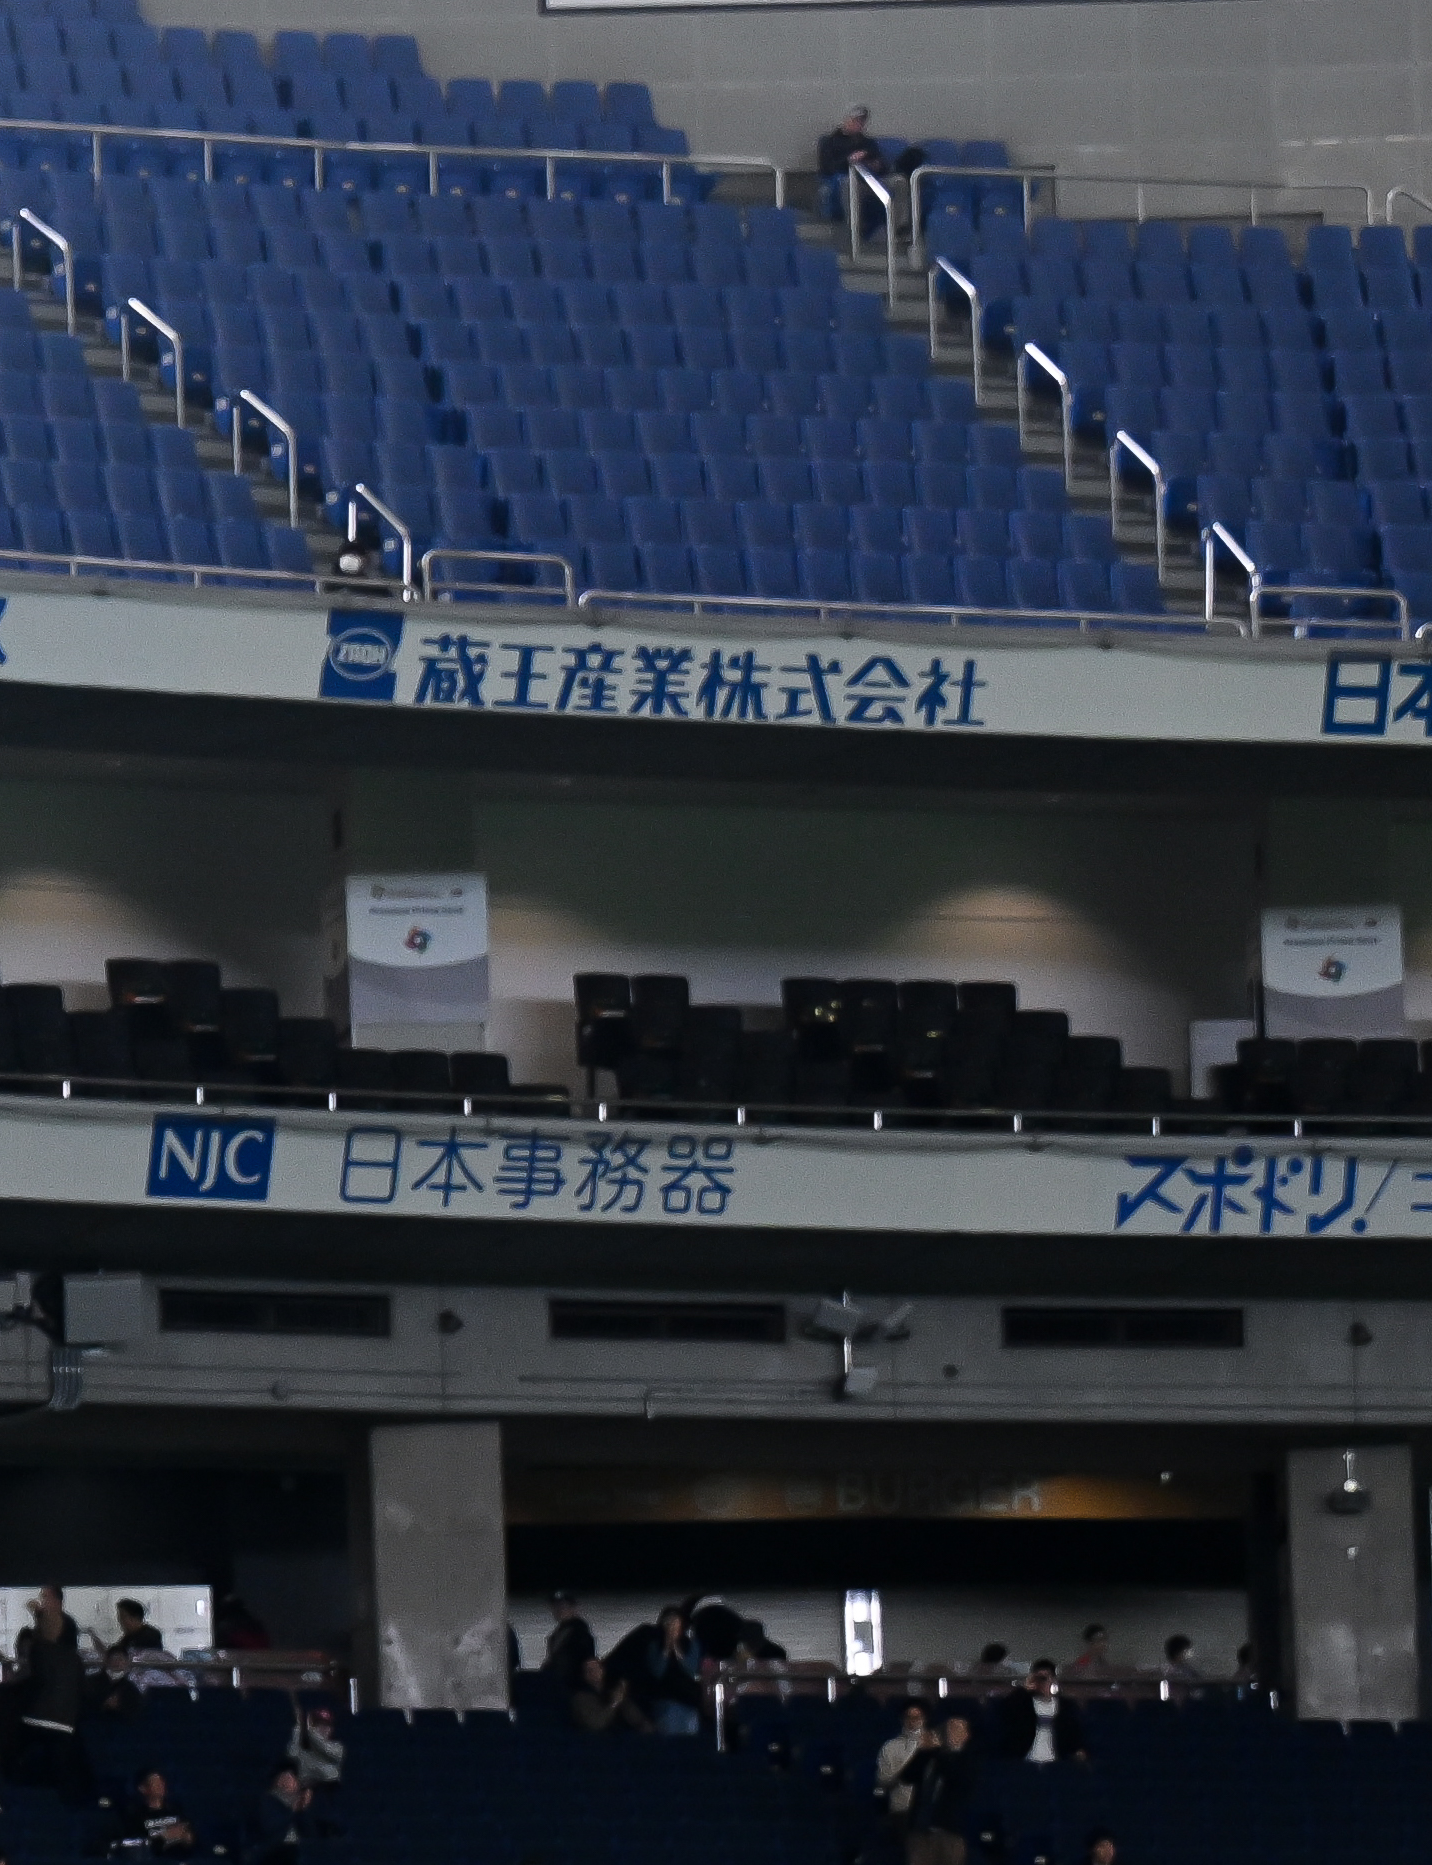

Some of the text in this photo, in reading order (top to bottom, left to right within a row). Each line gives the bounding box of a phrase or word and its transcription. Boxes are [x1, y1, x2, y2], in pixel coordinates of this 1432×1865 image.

[414, 634, 989, 727] 蔵王産業株式会社
[159, 1124, 735, 1215] NJC 日本事務器
